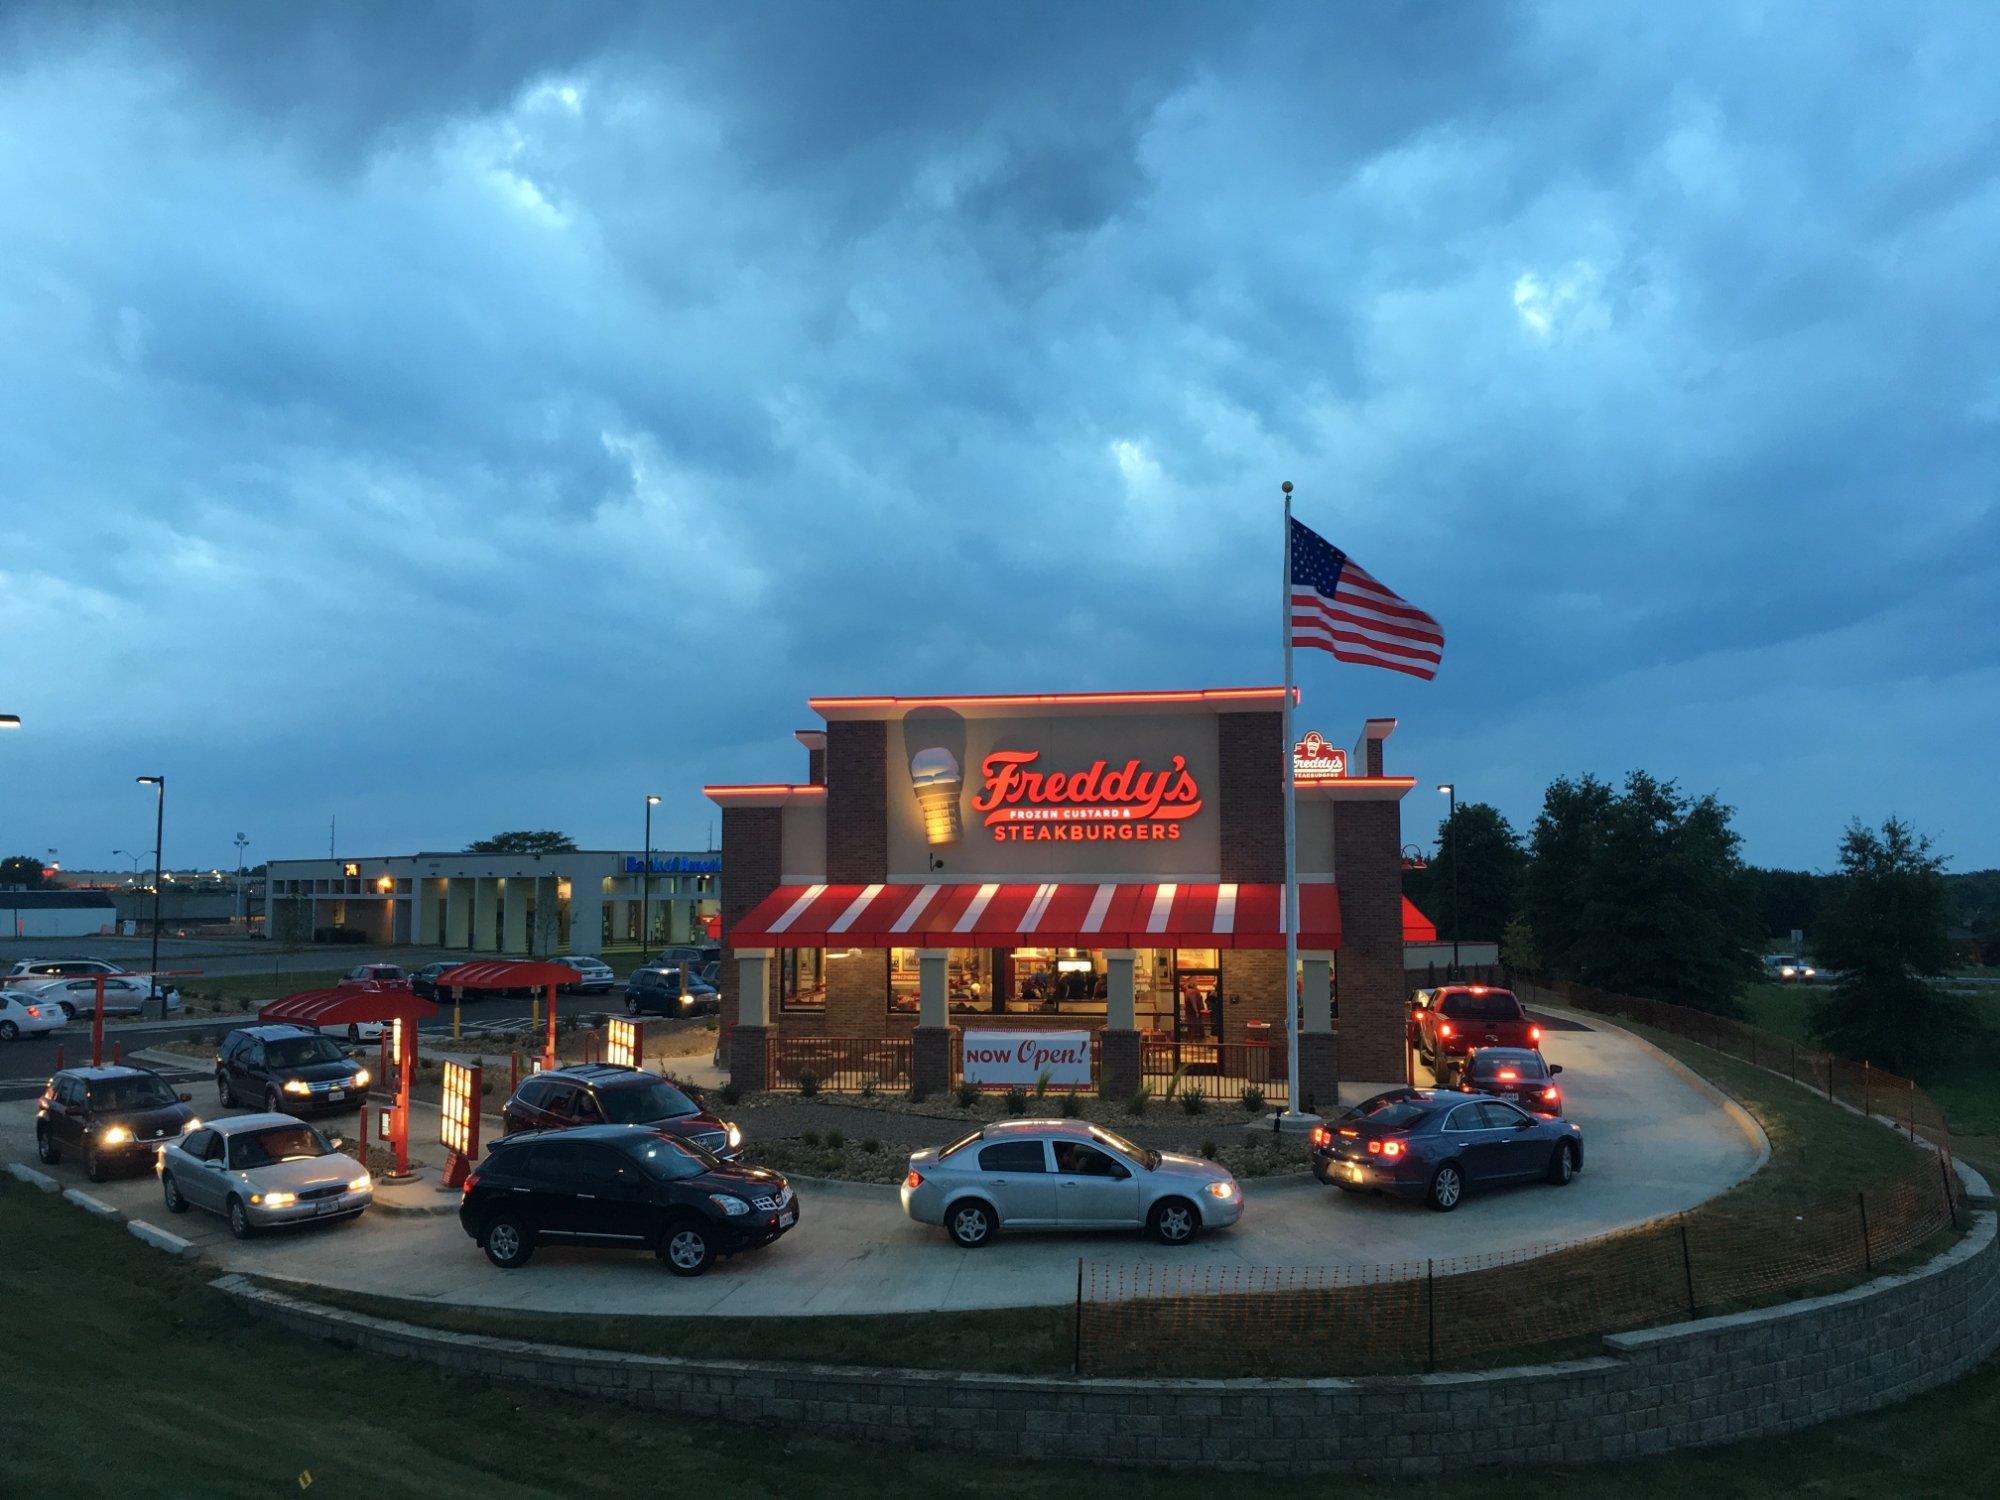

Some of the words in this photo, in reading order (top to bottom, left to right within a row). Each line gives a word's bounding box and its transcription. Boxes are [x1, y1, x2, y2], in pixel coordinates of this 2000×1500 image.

[972, 750, 1201, 818] Freddy's
[1009, 810, 1059, 819] FROZEN
[1063, 809, 1119, 819] CUSTARD
[1123, 808, 1131, 818] &
[994, 823, 1181, 841] STEAKBURGERS
[966, 1049, 1012, 1063] NOW
[1017, 1039, 1087, 1072] Open!
